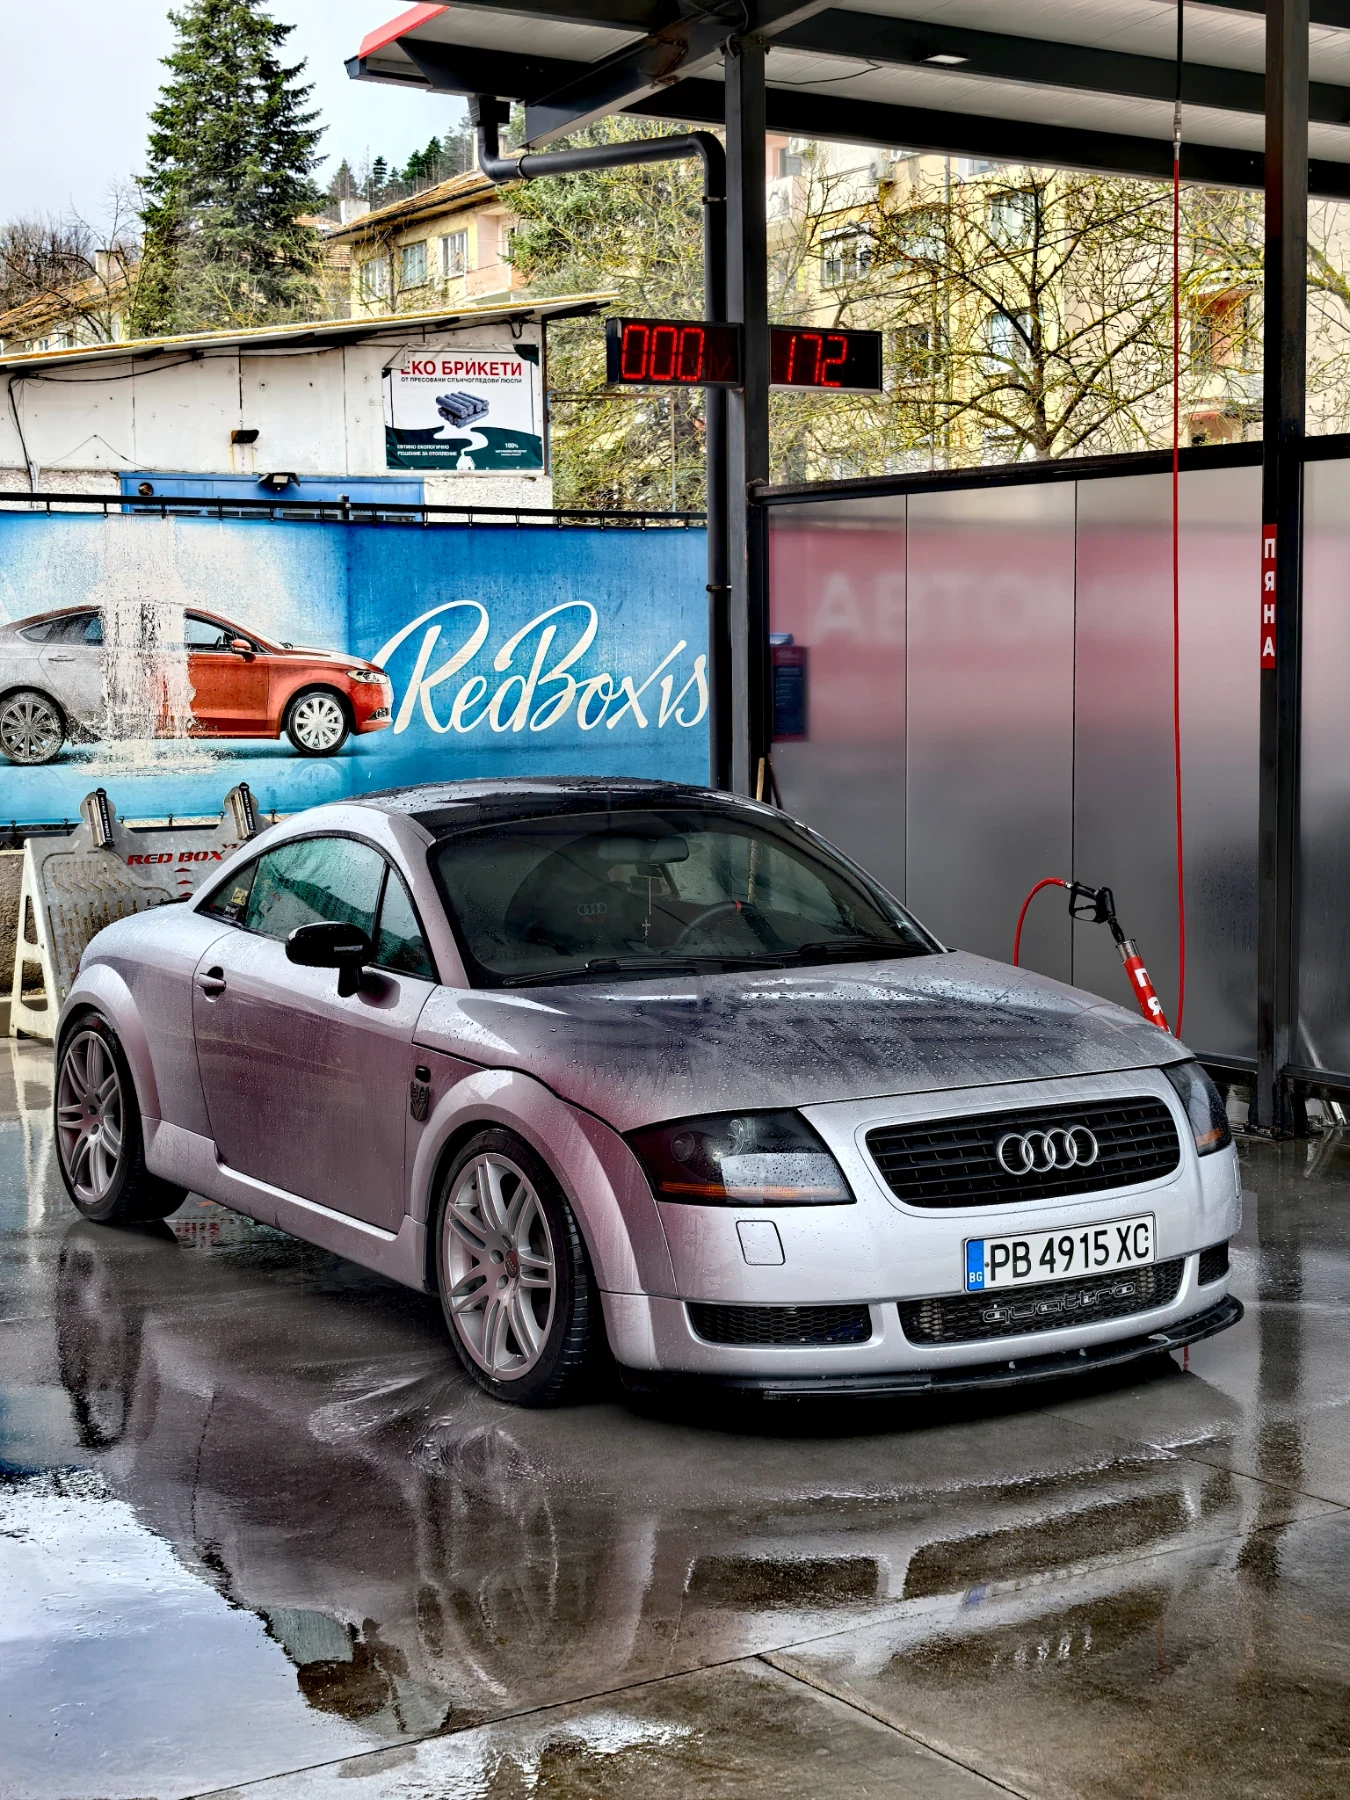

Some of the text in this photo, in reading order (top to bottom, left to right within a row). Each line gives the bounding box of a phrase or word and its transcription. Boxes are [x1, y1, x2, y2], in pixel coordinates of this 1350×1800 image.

[442, 360, 522, 376] БРИКЕТИ
[622, 325, 704, 381] 000
[787, 333, 848, 387] 172
[1262, 538, 1275, 657] ПЯНА
[126, 853, 173, 866] RED
[178, 850, 223, 862] BOX
[990, 1223, 1149, 1281] PB 4915 XC
[969, 1272, 982, 1283] BG
[983, 1283, 1136, 1324] quattro
